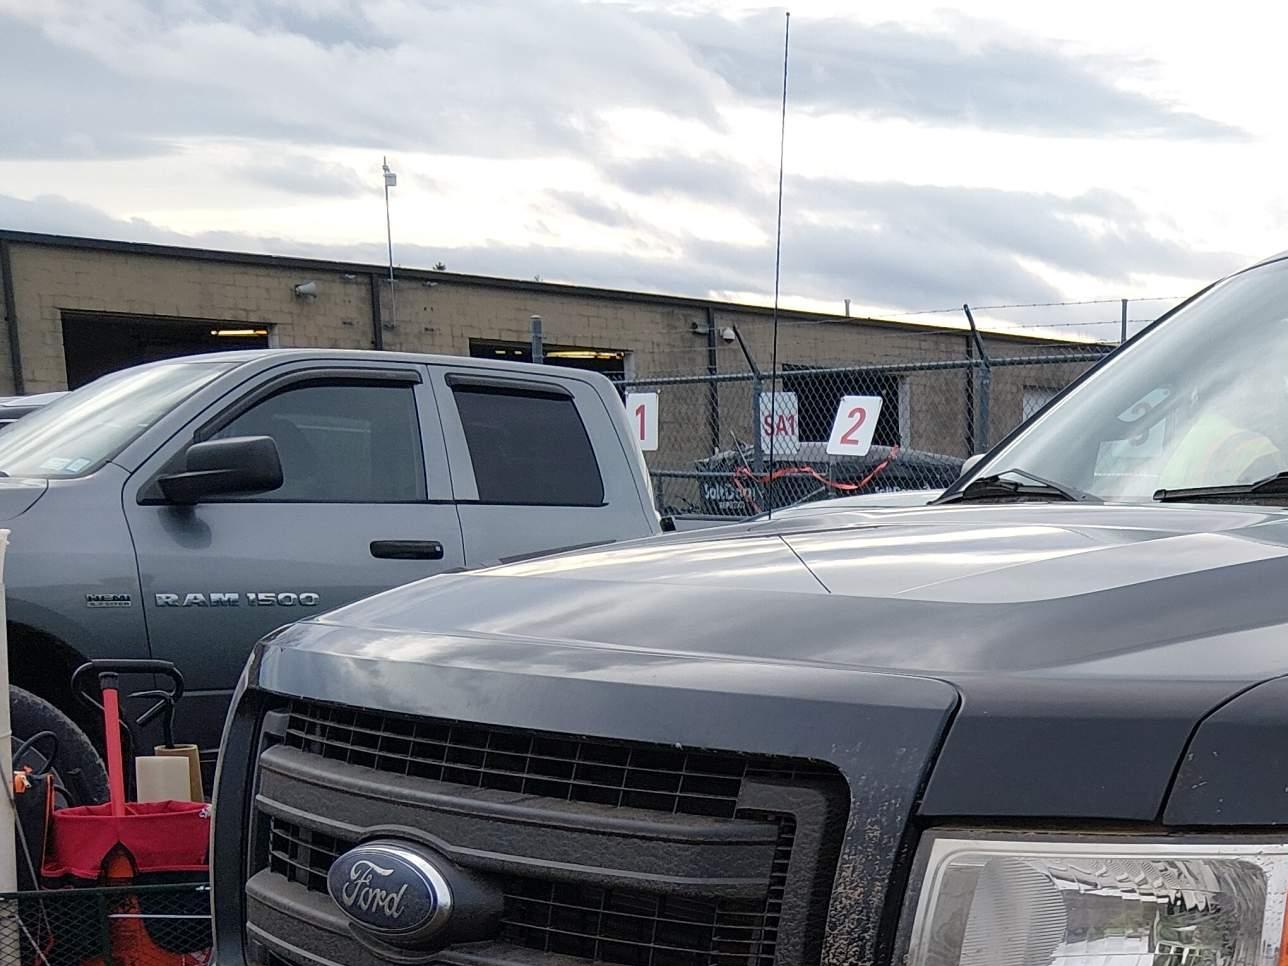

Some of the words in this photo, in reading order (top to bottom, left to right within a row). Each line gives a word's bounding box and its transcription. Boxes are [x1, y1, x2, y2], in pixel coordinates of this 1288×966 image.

[635, 404, 646, 440] 1
[763, 413, 798, 437] SA1
[839, 406, 867, 446] 2
[154, 592, 240, 608] RAM
[246, 592, 321, 607] 1500
[341, 859, 409, 920] Ford
